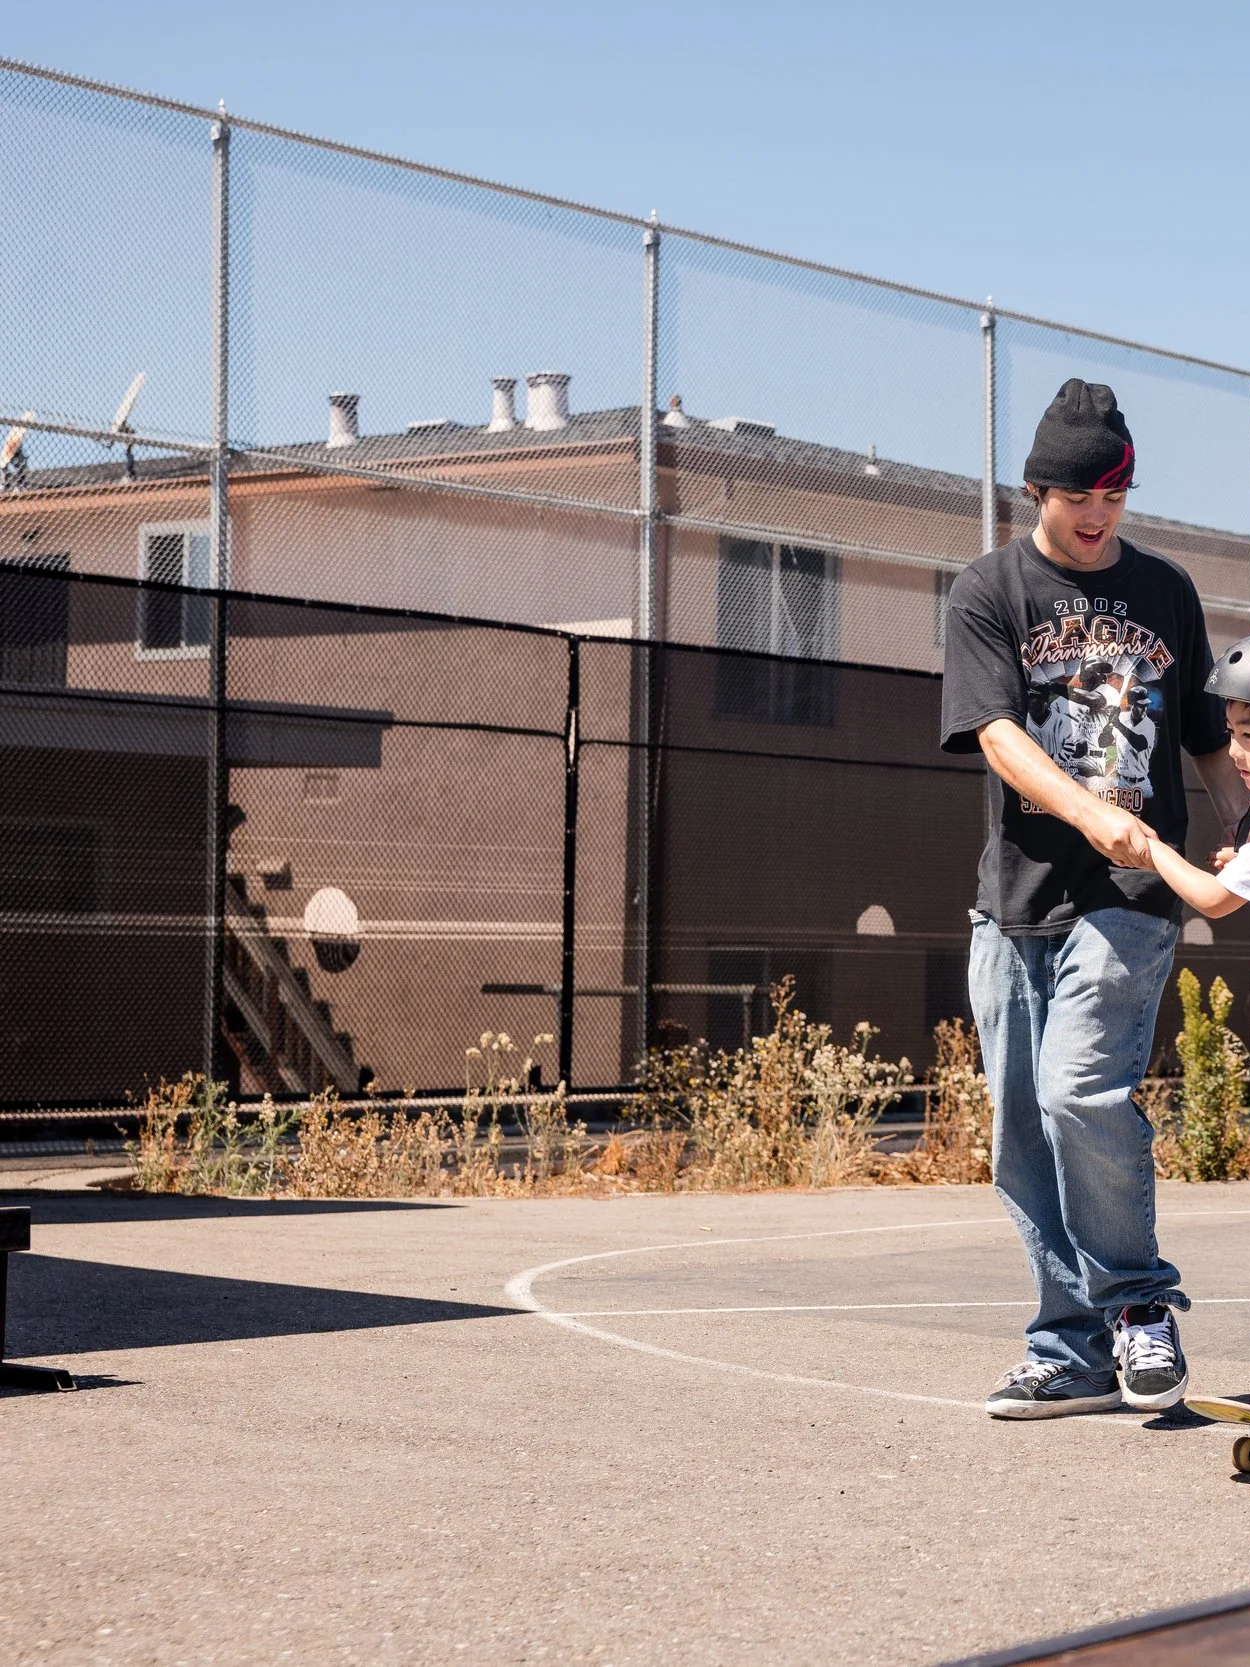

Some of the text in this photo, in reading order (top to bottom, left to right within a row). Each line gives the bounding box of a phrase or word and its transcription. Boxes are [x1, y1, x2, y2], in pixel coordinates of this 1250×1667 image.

[1054, 597, 1128, 616] 2002
[1029, 634, 1147, 666] Champions
[1097, 787, 1144, 812] NCISCO
